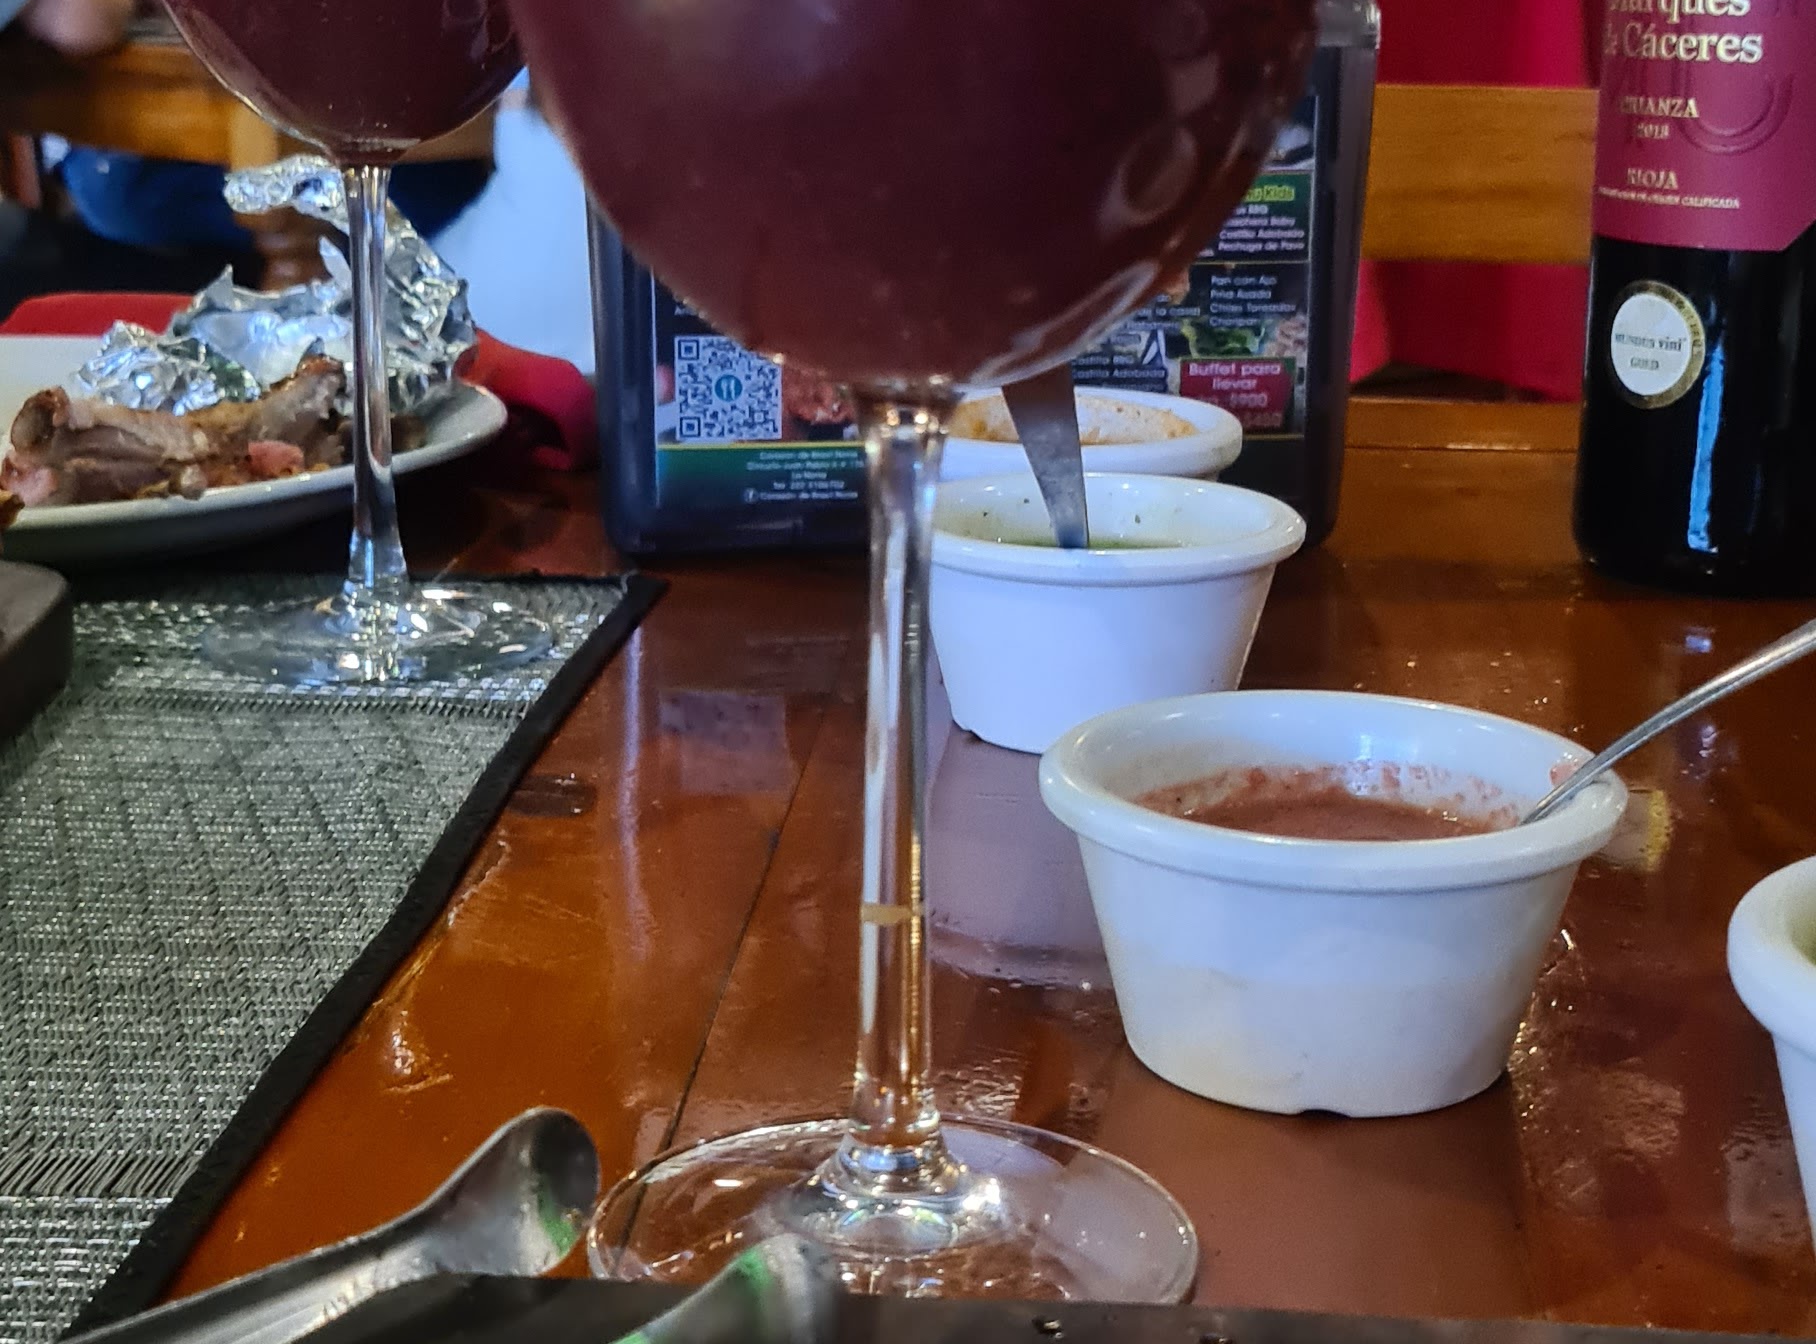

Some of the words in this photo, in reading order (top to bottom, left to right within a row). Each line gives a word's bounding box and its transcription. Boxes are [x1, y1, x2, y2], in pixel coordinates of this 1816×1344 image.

[1622, 21, 1763, 63] Cáceres
[1189, 361, 1236, 376] Buffet
[1241, 363, 1281, 377] para
[1212, 377, 1258, 391] llevar
